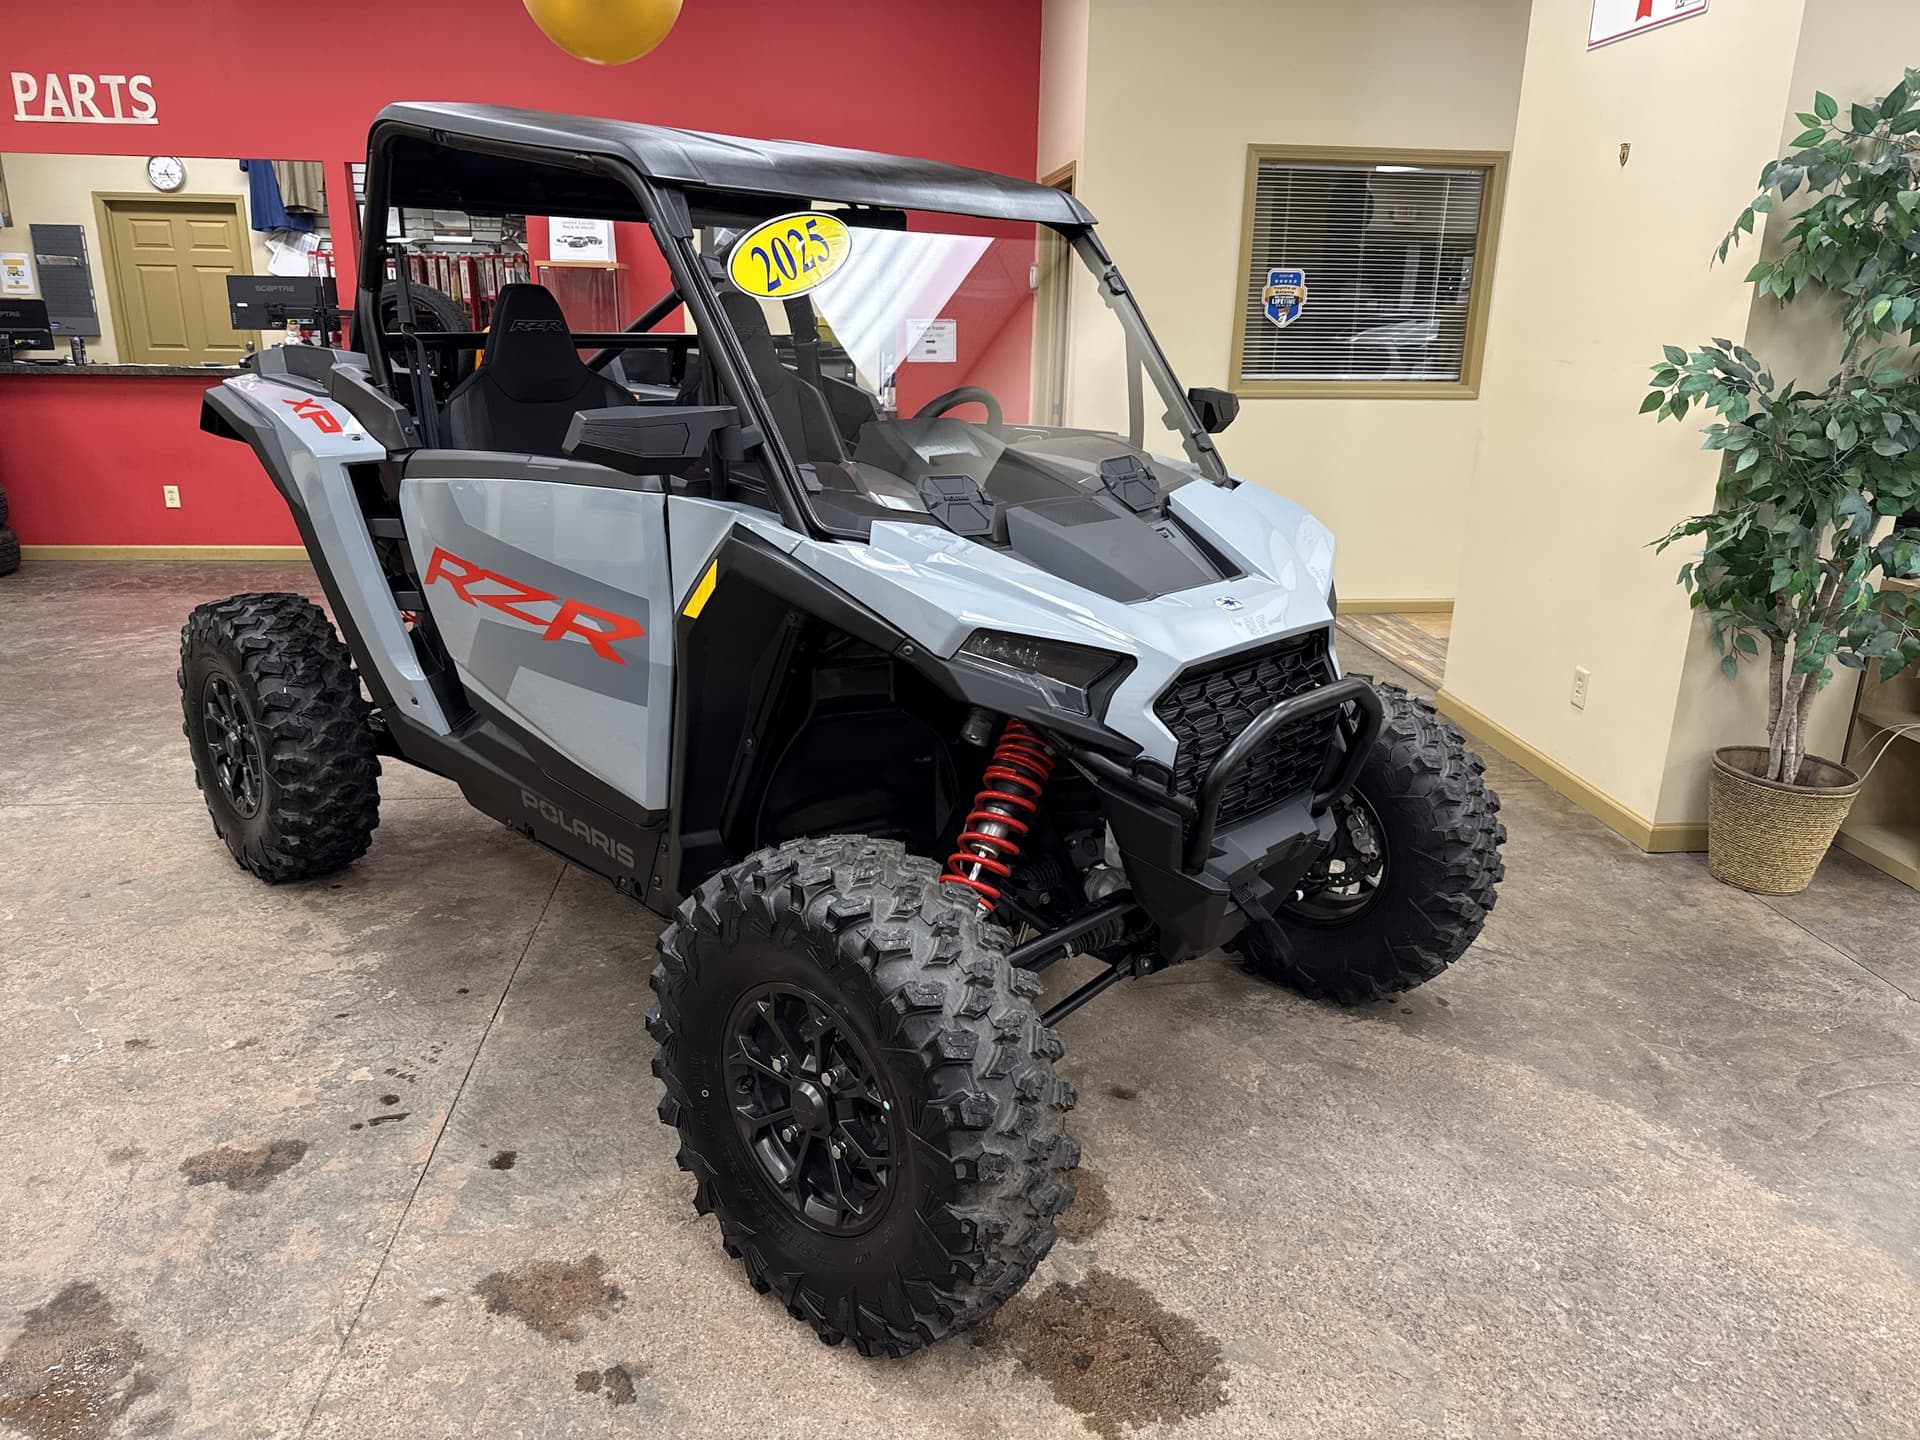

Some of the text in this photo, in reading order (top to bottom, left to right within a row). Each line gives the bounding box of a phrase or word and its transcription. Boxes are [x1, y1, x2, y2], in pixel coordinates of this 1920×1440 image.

[11, 72, 157, 121] PARTS
[751, 219, 830, 292] 2025
[509, 319, 563, 332] RZR
[282, 398, 343, 433] XP
[424, 546, 646, 667] RZR
[521, 788, 635, 869] POLARIS
